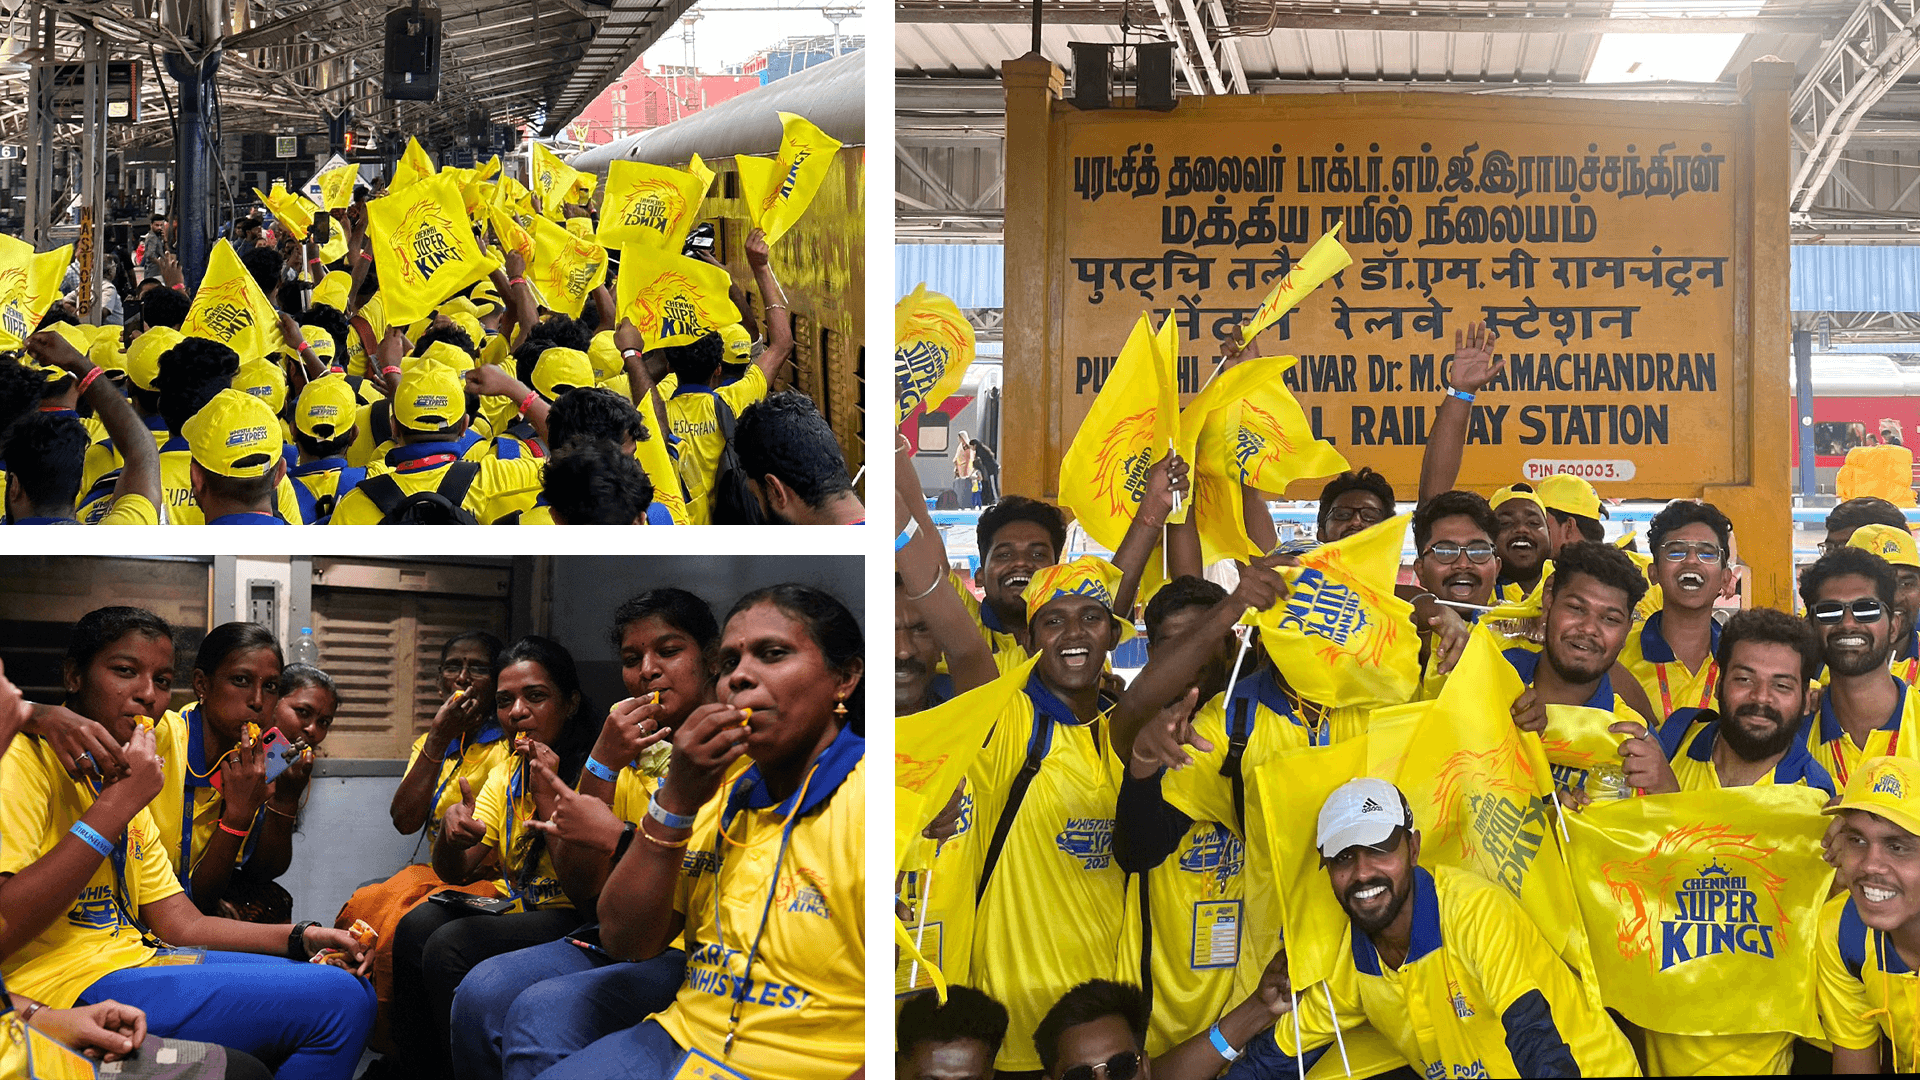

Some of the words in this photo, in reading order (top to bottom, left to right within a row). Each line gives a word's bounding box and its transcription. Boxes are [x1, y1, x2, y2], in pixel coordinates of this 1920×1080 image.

[1165, 143, 1286, 199] தலைவர்
[1161, 195, 1309, 250] மத்திய
[1418, 193, 1597, 249] நிலையம்
[413, 232, 449, 258] SUPER
[414, 246, 464, 282] KINGS
[663, 306, 701, 328] SUPR
[903, 340, 937, 395] SUPE
[1351, 405, 1511, 445] RAILAY
[1518, 404, 1668, 445] STATION
[1528, 464, 1553, 478] PIN
[1307, 580, 1349, 640] SUPE
[1682, 876, 1747, 890] CHENNAI
[1674, 890, 1760, 924] SUPER
[1659, 921, 1775, 973] KINGS
